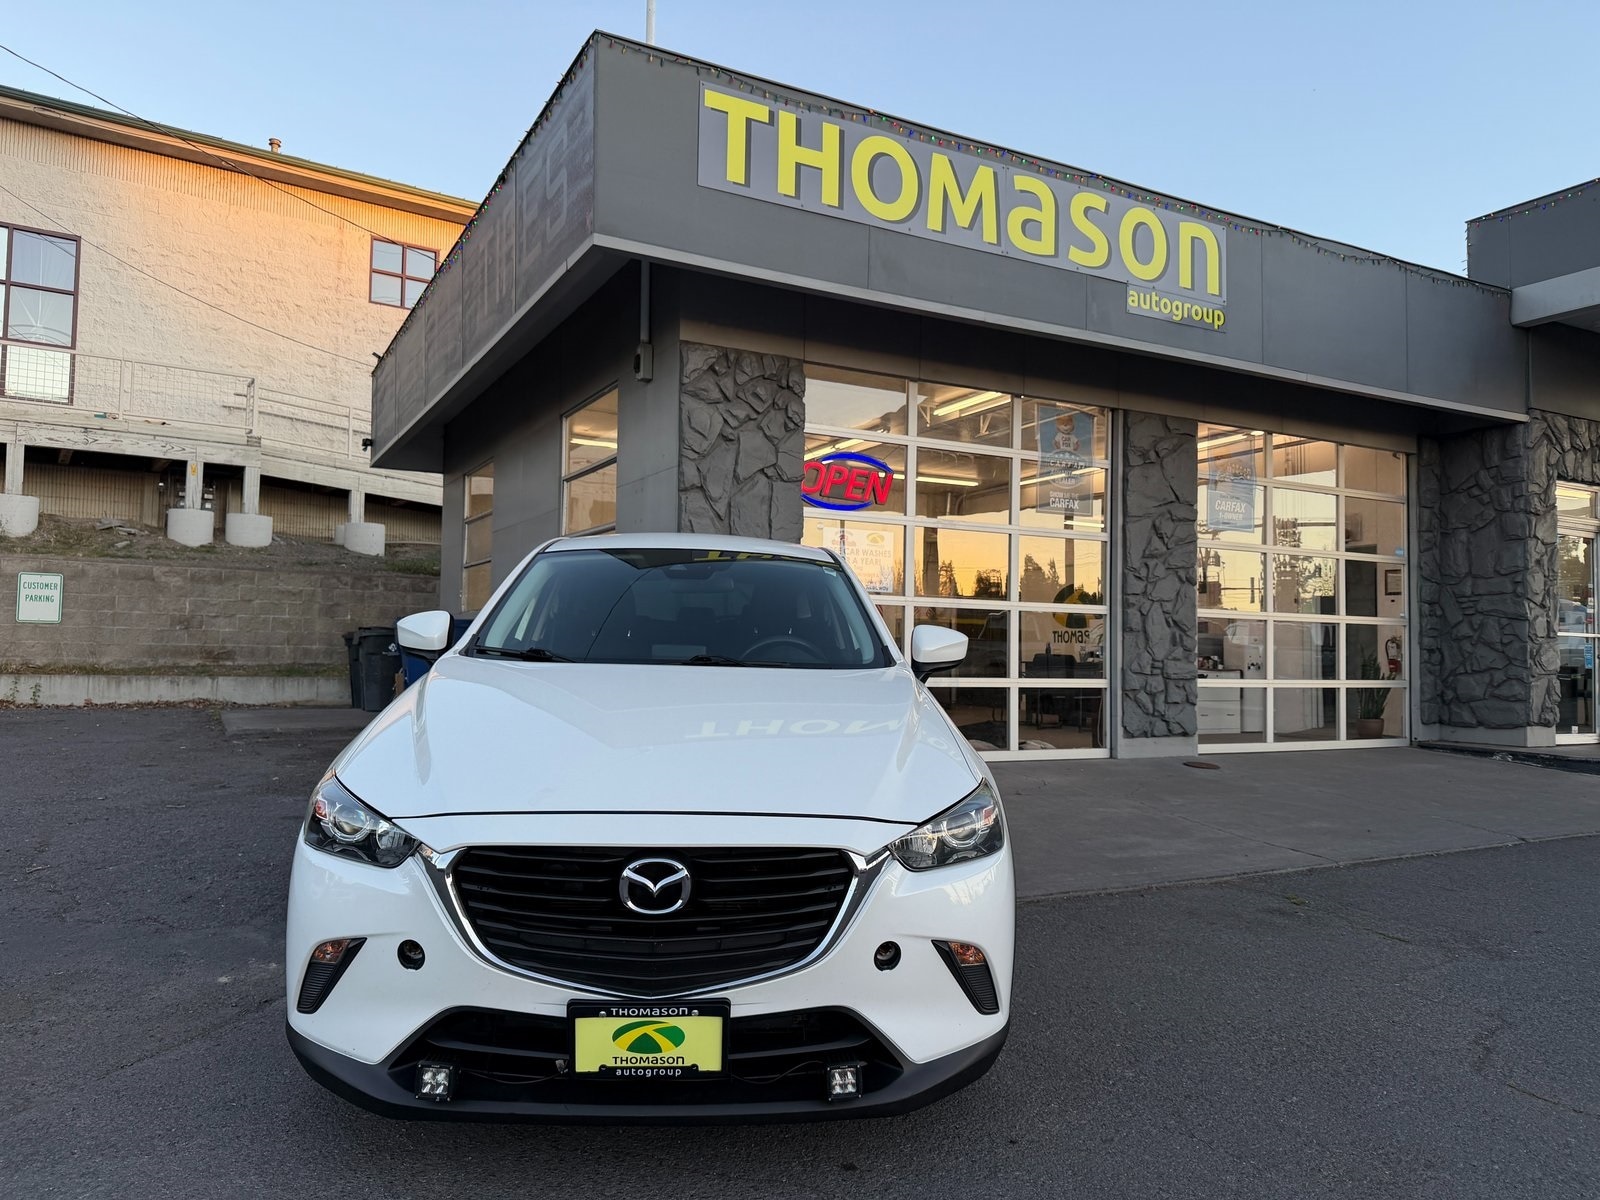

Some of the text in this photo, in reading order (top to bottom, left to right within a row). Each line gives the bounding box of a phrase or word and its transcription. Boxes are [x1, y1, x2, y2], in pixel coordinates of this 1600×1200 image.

[1127, 288, 1225, 330] autogroup
[801, 462, 894, 504] OPEN
[1049, 497, 1079, 509] CARFAX
[1215, 500, 1246, 512] CARFAX
[861, 548, 891, 558] WASHES
[23, 581, 58, 590] CUSTOMER
[25, 594, 54, 603] PARKING
[616, 1067, 682, 1077] autogroup
